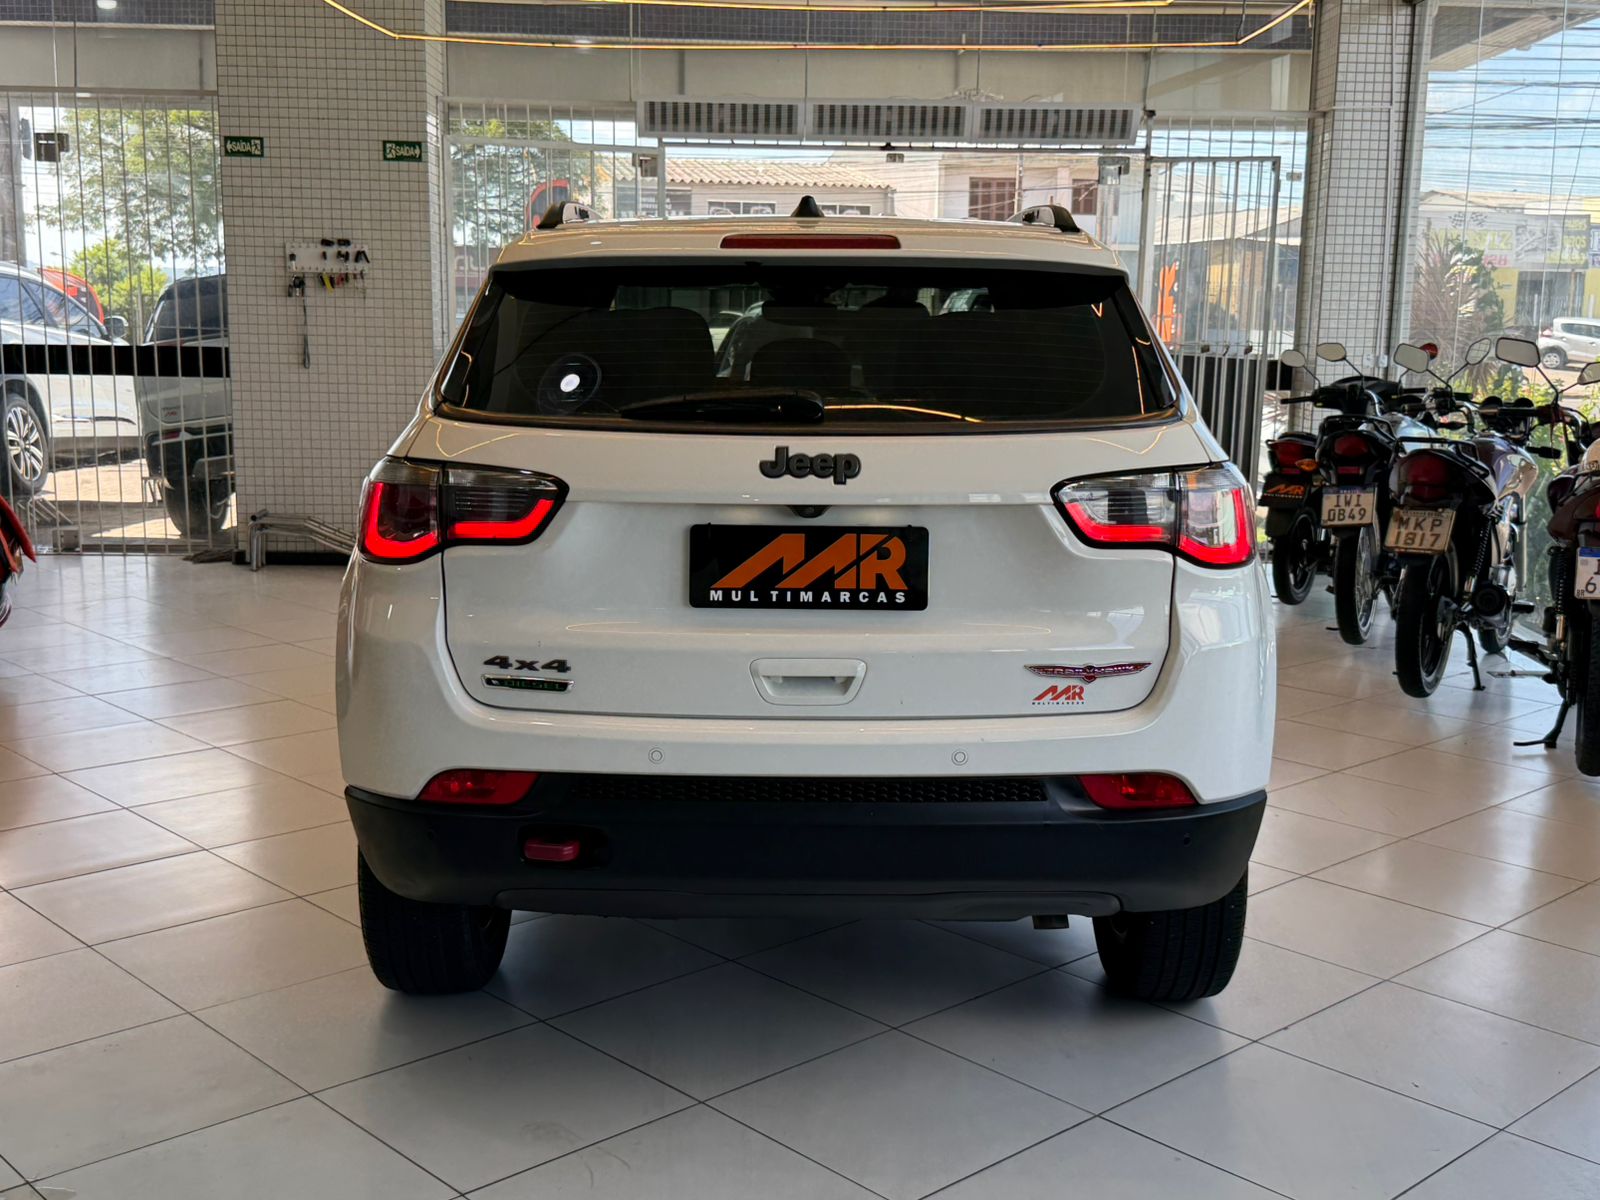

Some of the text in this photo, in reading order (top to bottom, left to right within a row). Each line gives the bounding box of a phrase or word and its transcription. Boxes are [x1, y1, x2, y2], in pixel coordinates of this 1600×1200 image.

[759, 446, 861, 485] Jeep
[1334, 494, 1361, 507] IWI
[1396, 516, 1442, 532] MKP
[1394, 531, 1441, 548] 1817
[710, 590, 906, 603] MULTIMARCAS
[483, 655, 571, 673] 4x4
